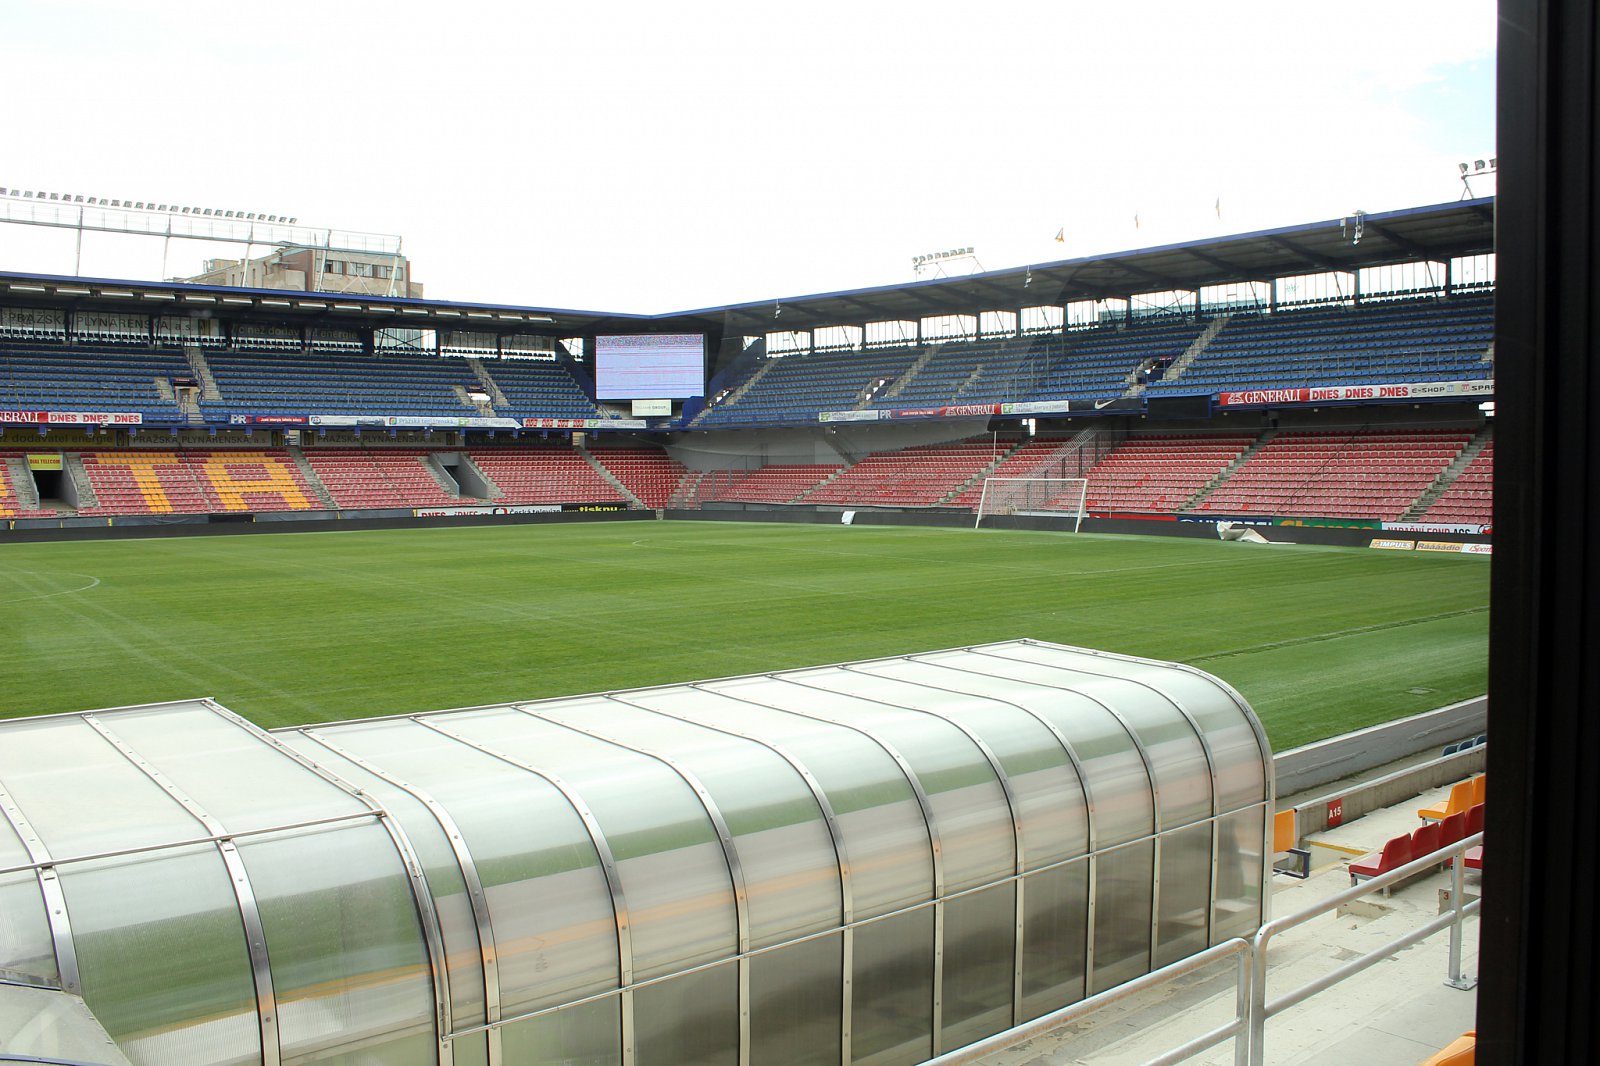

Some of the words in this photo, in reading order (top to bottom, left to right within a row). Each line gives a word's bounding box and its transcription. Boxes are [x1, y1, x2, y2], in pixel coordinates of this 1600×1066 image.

[1245, 389, 1300, 403] GENERALI
[1312, 389, 1339, 400] DNES
[1345, 388, 1373, 398] DNES
[1380, 386, 1408, 397] DNES
[957, 404, 995, 416] GENERALI
[50, 414, 77, 422] DNES
[83, 414, 108, 422] DNES
[114, 414, 140, 423] DNES
[1328, 806, 1342, 819] A15
[1443, 891, 1449, 900] 3
